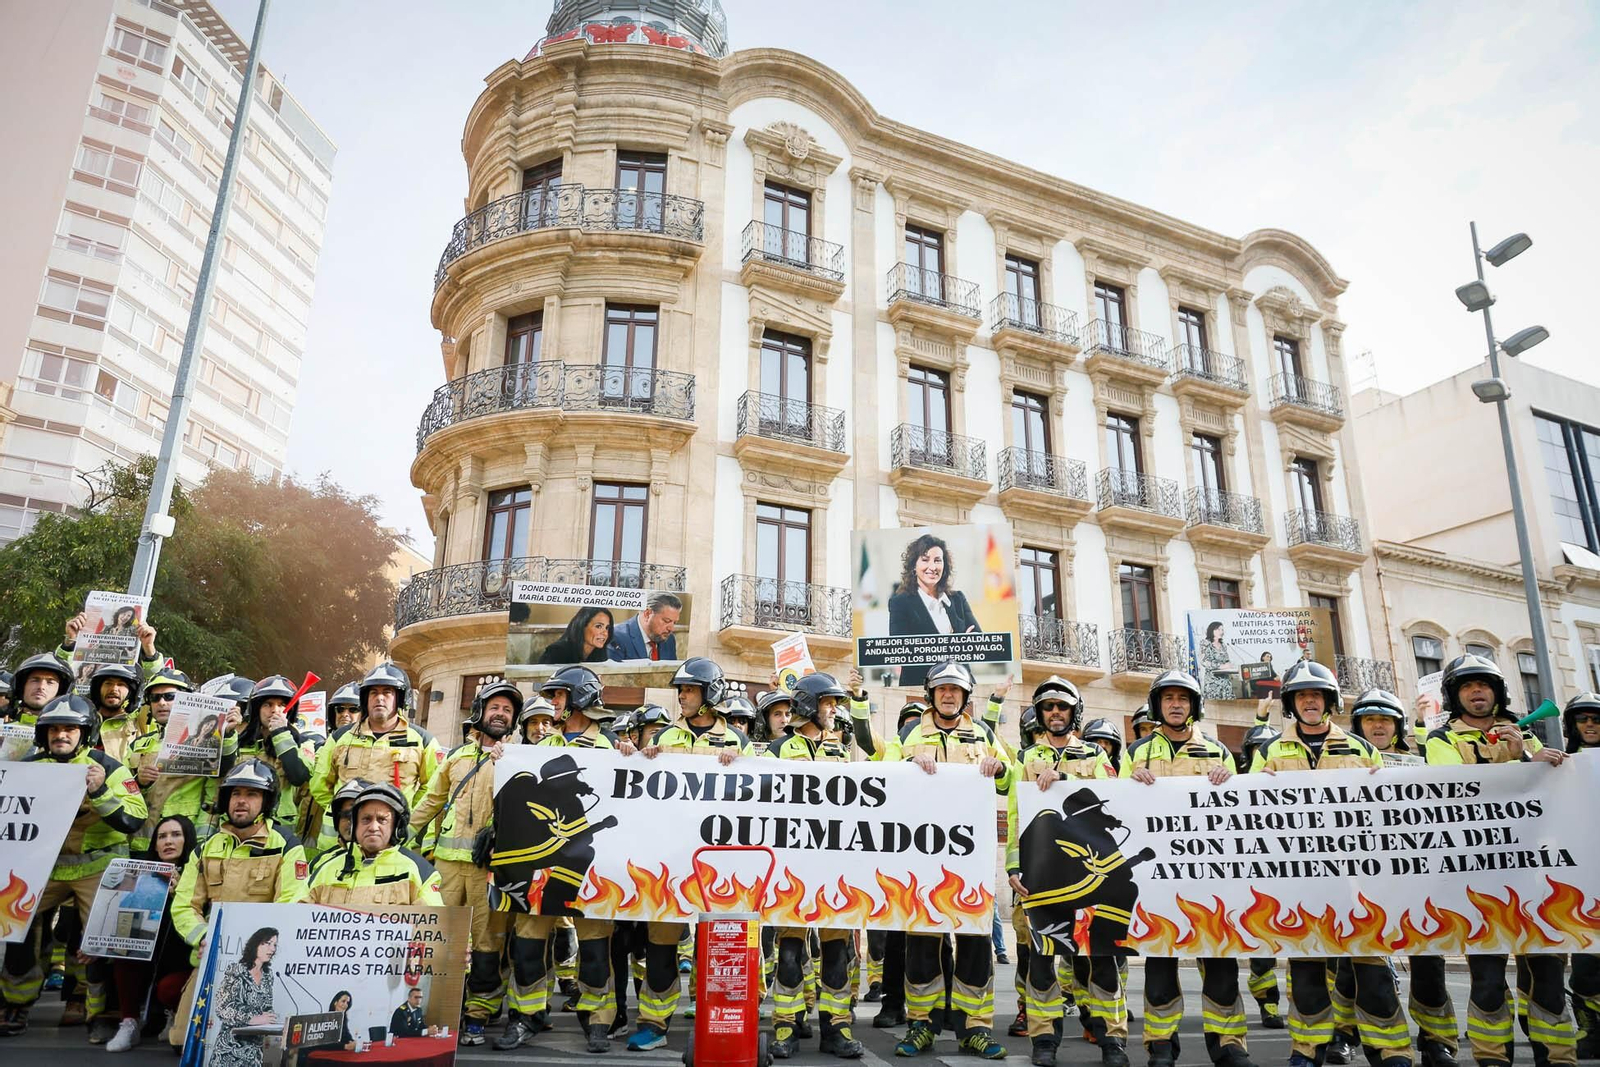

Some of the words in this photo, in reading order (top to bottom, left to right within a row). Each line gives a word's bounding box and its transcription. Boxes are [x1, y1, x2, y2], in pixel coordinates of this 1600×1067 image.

[518, 584, 550, 593] "DONDE
[571, 588, 593, 596] DIGO,
[617, 590, 645, 598] DIEGO"
[584, 598, 613, 606] GARCÍA
[875, 638, 902, 646] MEJOR
[904, 637, 936, 645] SUELDO
[950, 634, 990, 643] ALCALDÍA
[865, 646, 912, 656] ANDALUCÍA,
[914, 645, 947, 654] PORQUE
[975, 643, 1005, 652] VALGO,
[926, 654, 971, 662] BOMBEROS
[610, 768, 887, 808] BOMBEROS
[1189, 790, 1240, 809] LAS
[1249, 781, 1481, 807] INSTALACIONES
[1146, 815, 1198, 833] DEL
[1205, 811, 1326, 832] PARQUE
[1334, 809, 1373, 828] DE
[1382, 799, 1544, 826] BOMBEROS
[700, 814, 975, 856] QUEMADOS
[1170, 838, 1226, 856] SON
[1235, 837, 1270, 855] LA
[1275, 830, 1455, 853] VERGÜENZA
[1464, 827, 1519, 846] DEL
[1150, 858, 1382, 880] AYUNTAMIENTO
[1391, 857, 1430, 875] DE
[1438, 845, 1577, 874] ALMERÍA
[311, 911, 362, 924] VAMOS
[365, 913, 375, 923] A
[379, 913, 438, 925] CONTAR
[296, 928, 371, 941] MENTIRAS
[375, 930, 447, 944] TRALARA,
[306, 946, 357, 958] VAMOS
[360, 947, 370, 958] A
[374, 947, 434, 959] CONTAR
[285, 963, 360, 975] MENTIRAS
[364, 964, 447, 976] TRALARA...
[307, 1019, 339, 1034] ALMERÍA
